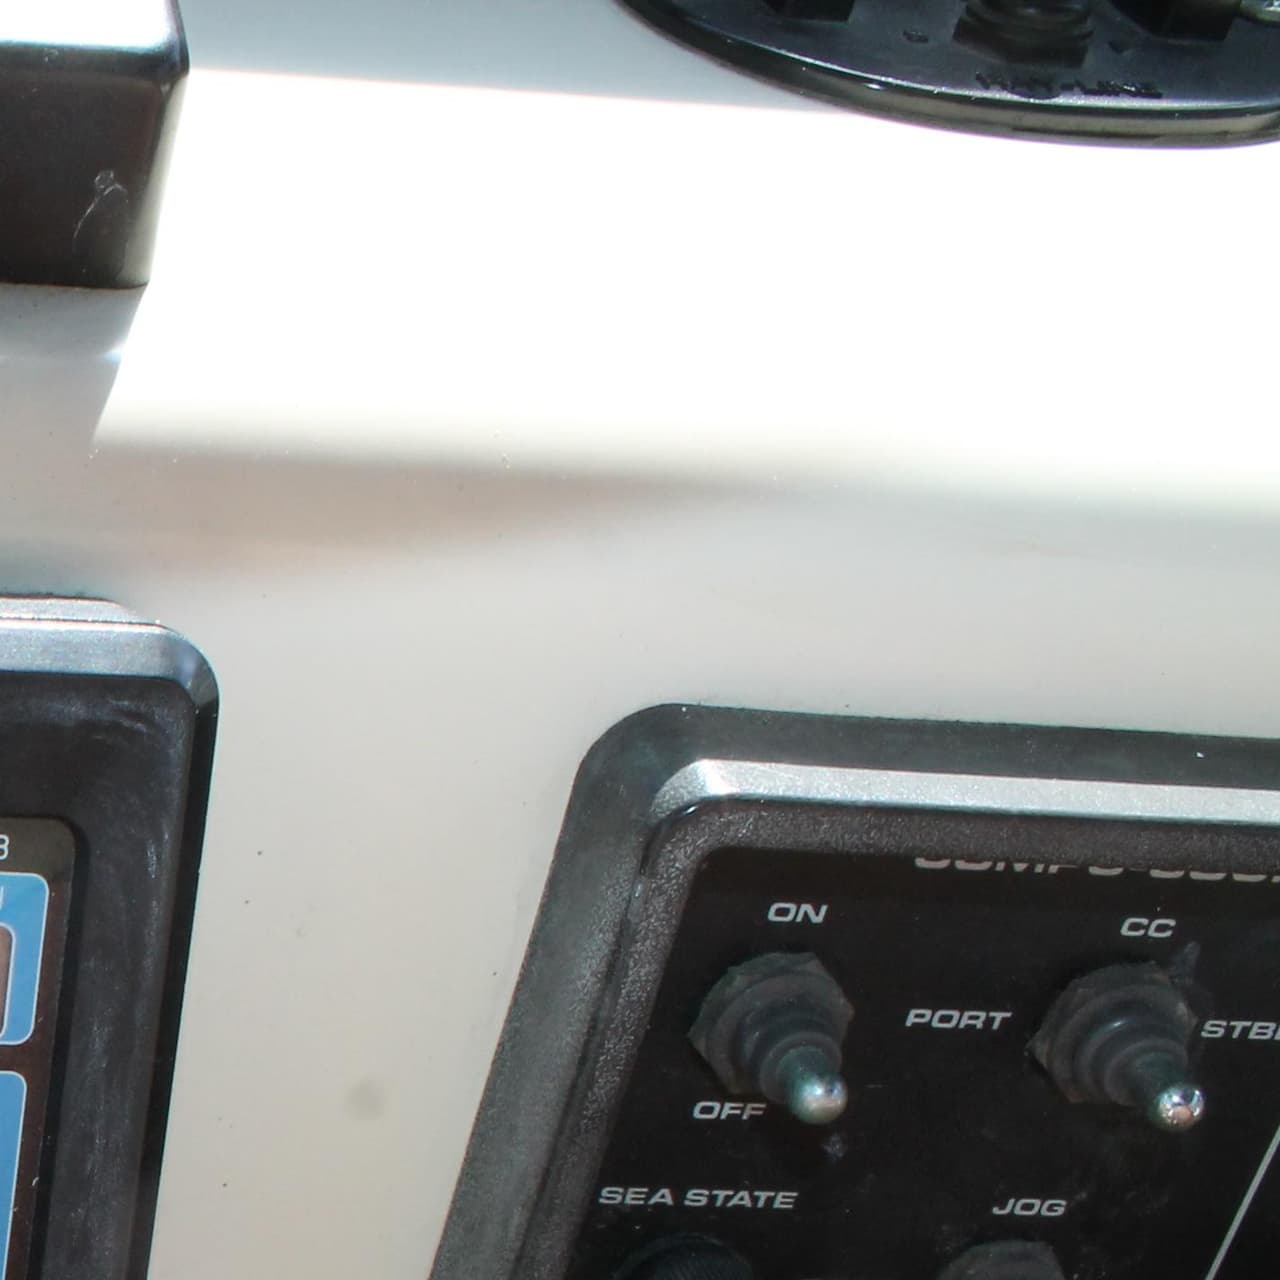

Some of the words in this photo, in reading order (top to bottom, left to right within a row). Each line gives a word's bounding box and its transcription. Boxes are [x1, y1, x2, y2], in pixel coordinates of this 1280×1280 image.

[767, 902, 828, 924] ON
[1120, 917, 1177, 938] CC
[905, 1008, 1013, 1030] PORT
[692, 1100, 766, 1120] OFF
[598, 1187, 674, 1207] SEA
[683, 1188, 799, 1209] STATE
[992, 1198, 1068, 1217] JOG
